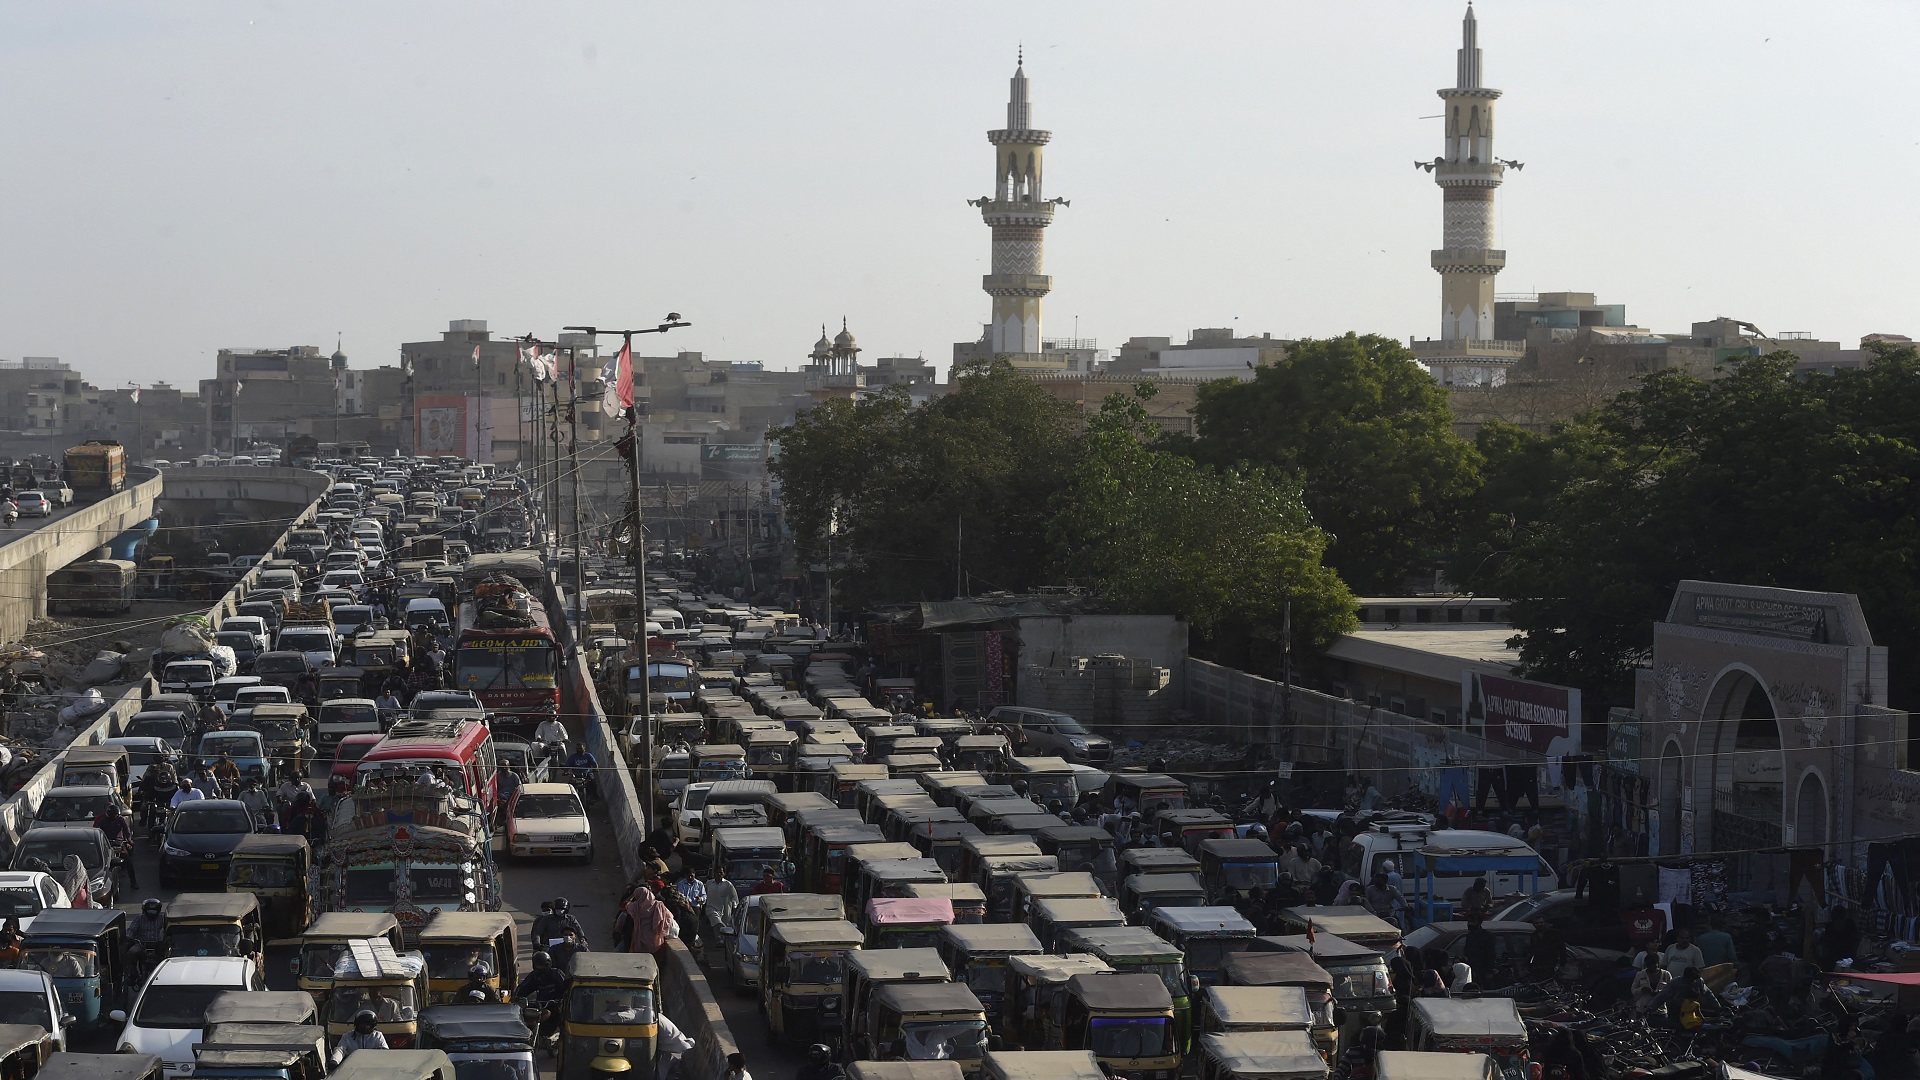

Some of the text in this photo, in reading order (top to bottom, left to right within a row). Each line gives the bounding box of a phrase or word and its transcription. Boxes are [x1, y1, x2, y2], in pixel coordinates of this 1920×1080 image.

[1696, 596, 1714, 610] APWA
[1486, 694, 1567, 729] APWA GOVT HIGH SECONDARY
[1505, 719, 1532, 743] SCHOOL
[1614, 736, 1628, 753] Girls
